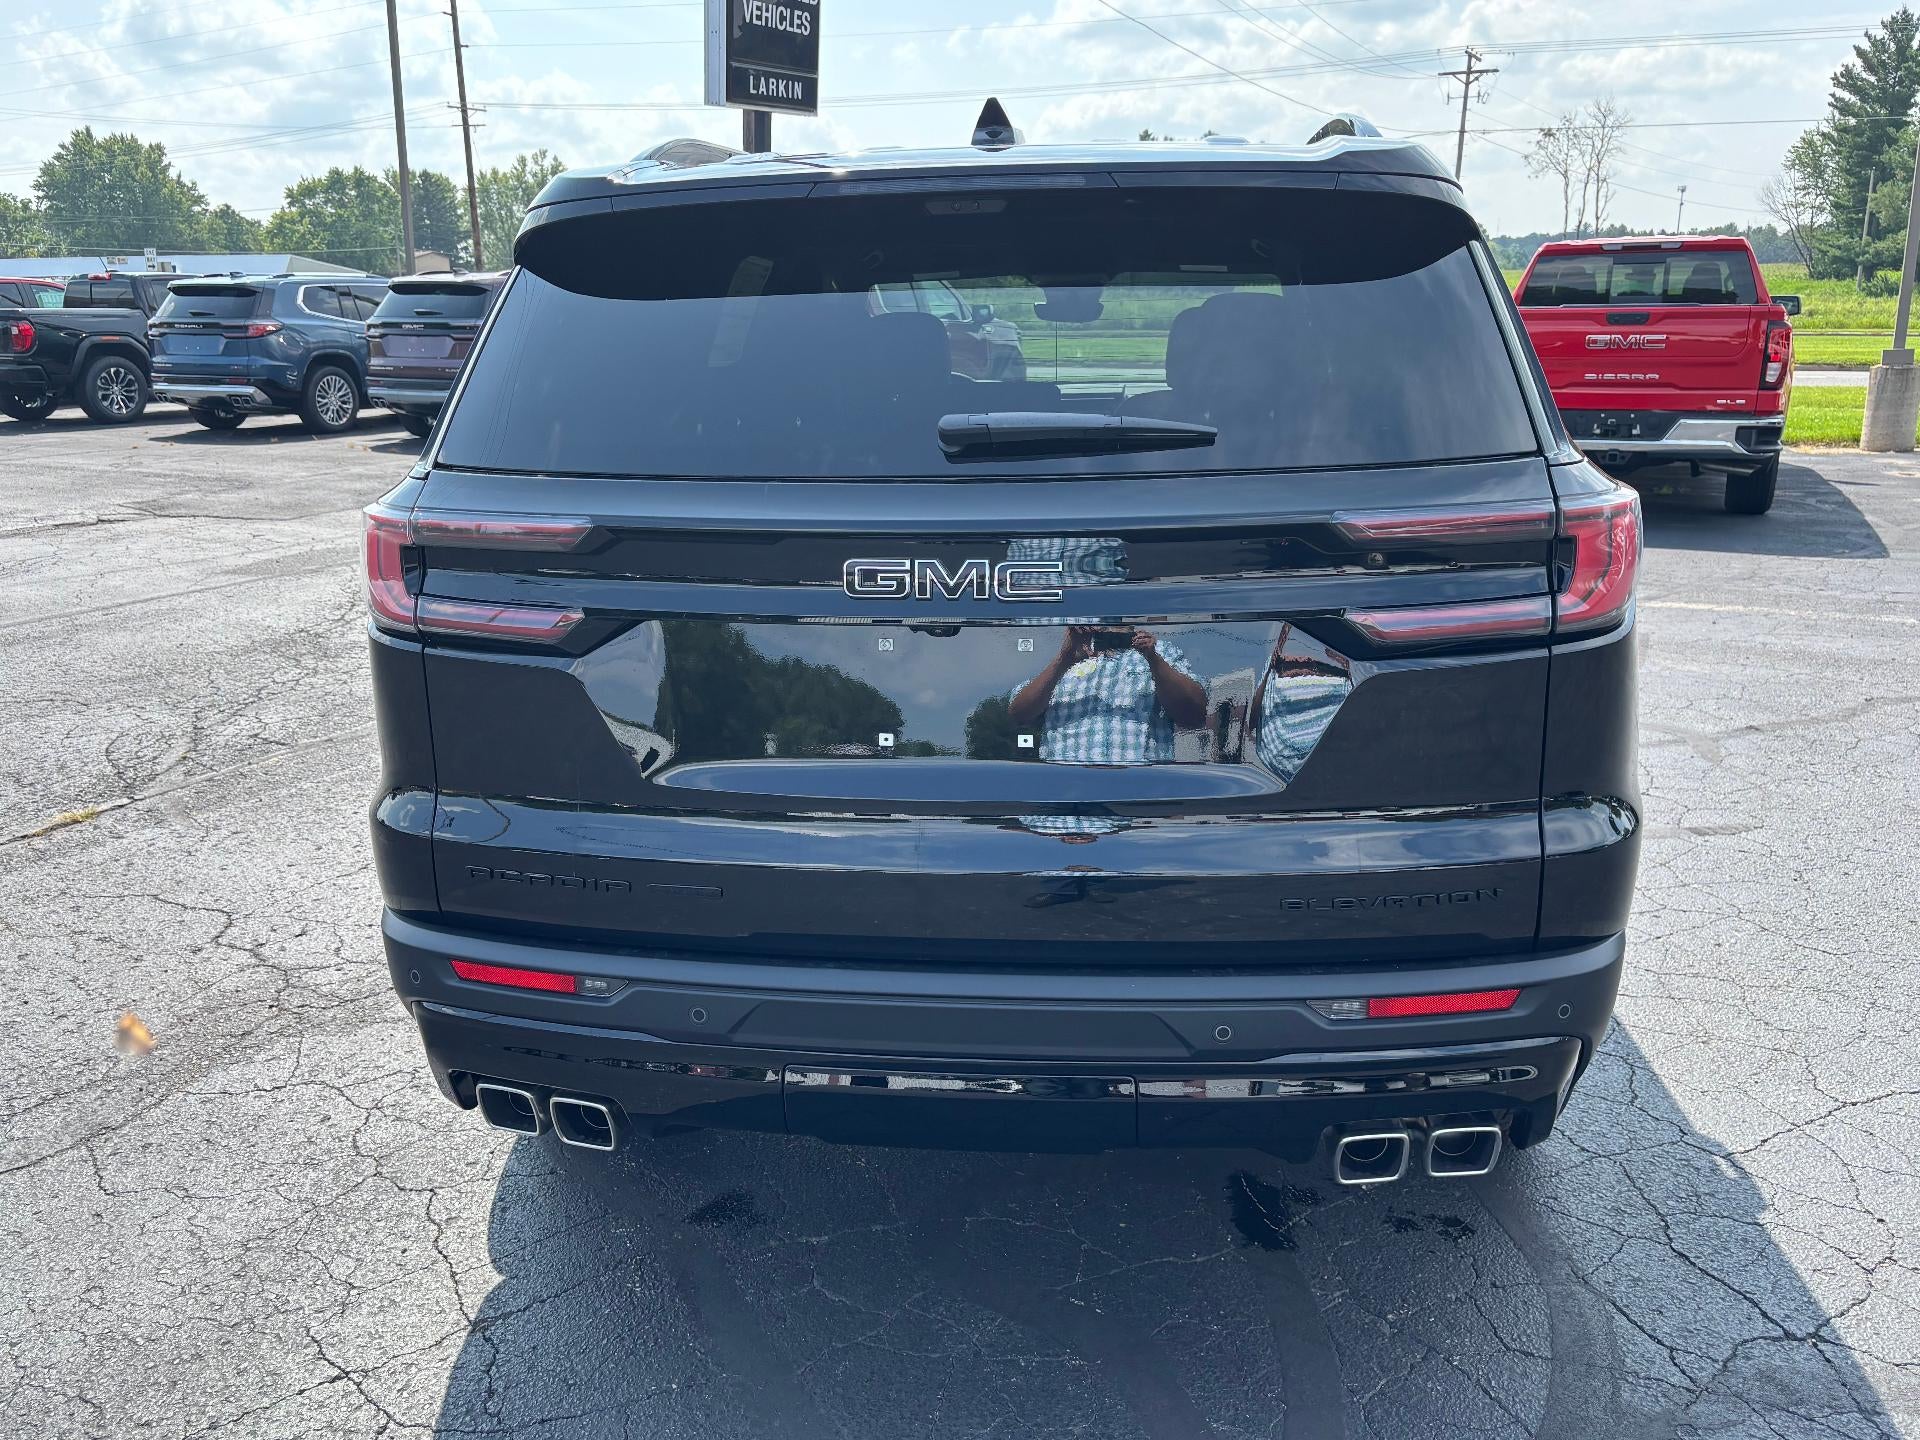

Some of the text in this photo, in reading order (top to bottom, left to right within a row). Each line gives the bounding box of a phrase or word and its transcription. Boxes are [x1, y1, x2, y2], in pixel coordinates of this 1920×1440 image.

[743, 0, 811, 36] VEHICLES
[749, 75, 802, 100] LARKIN
[1585, 334, 1667, 349] GMC
[843, 559, 1063, 600] GMC
[465, 865, 632, 893] ACADIA
[1279, 887, 1504, 913] ELEVATION
